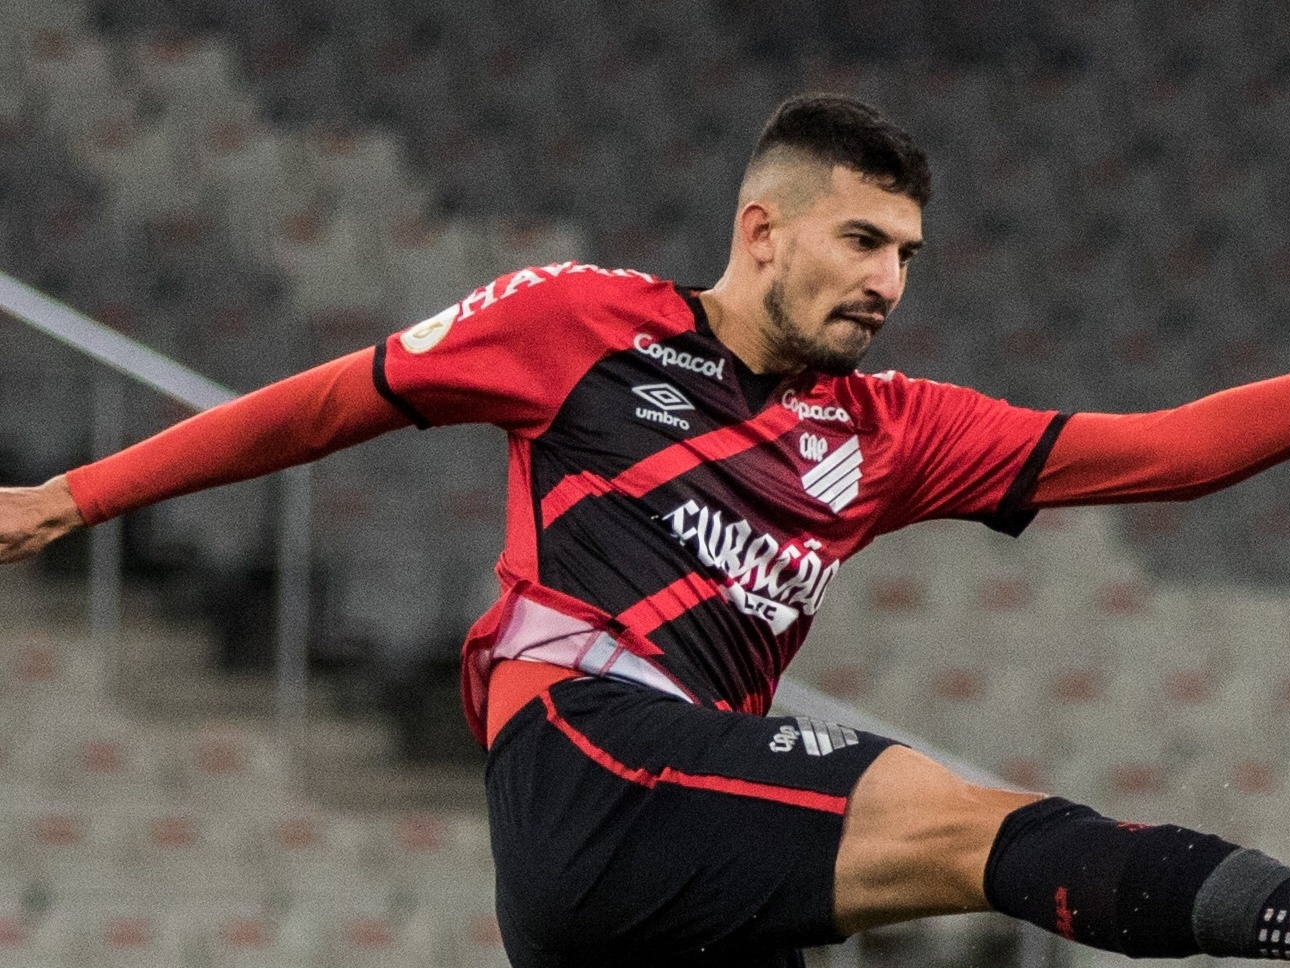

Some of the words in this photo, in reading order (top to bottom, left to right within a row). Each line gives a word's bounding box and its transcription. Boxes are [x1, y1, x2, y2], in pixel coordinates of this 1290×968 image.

[633, 333, 725, 381] Copacol
[635, 406, 690, 431] umbro
[781, 387, 853, 427] Copaco
[799, 432, 829, 463] CAP
